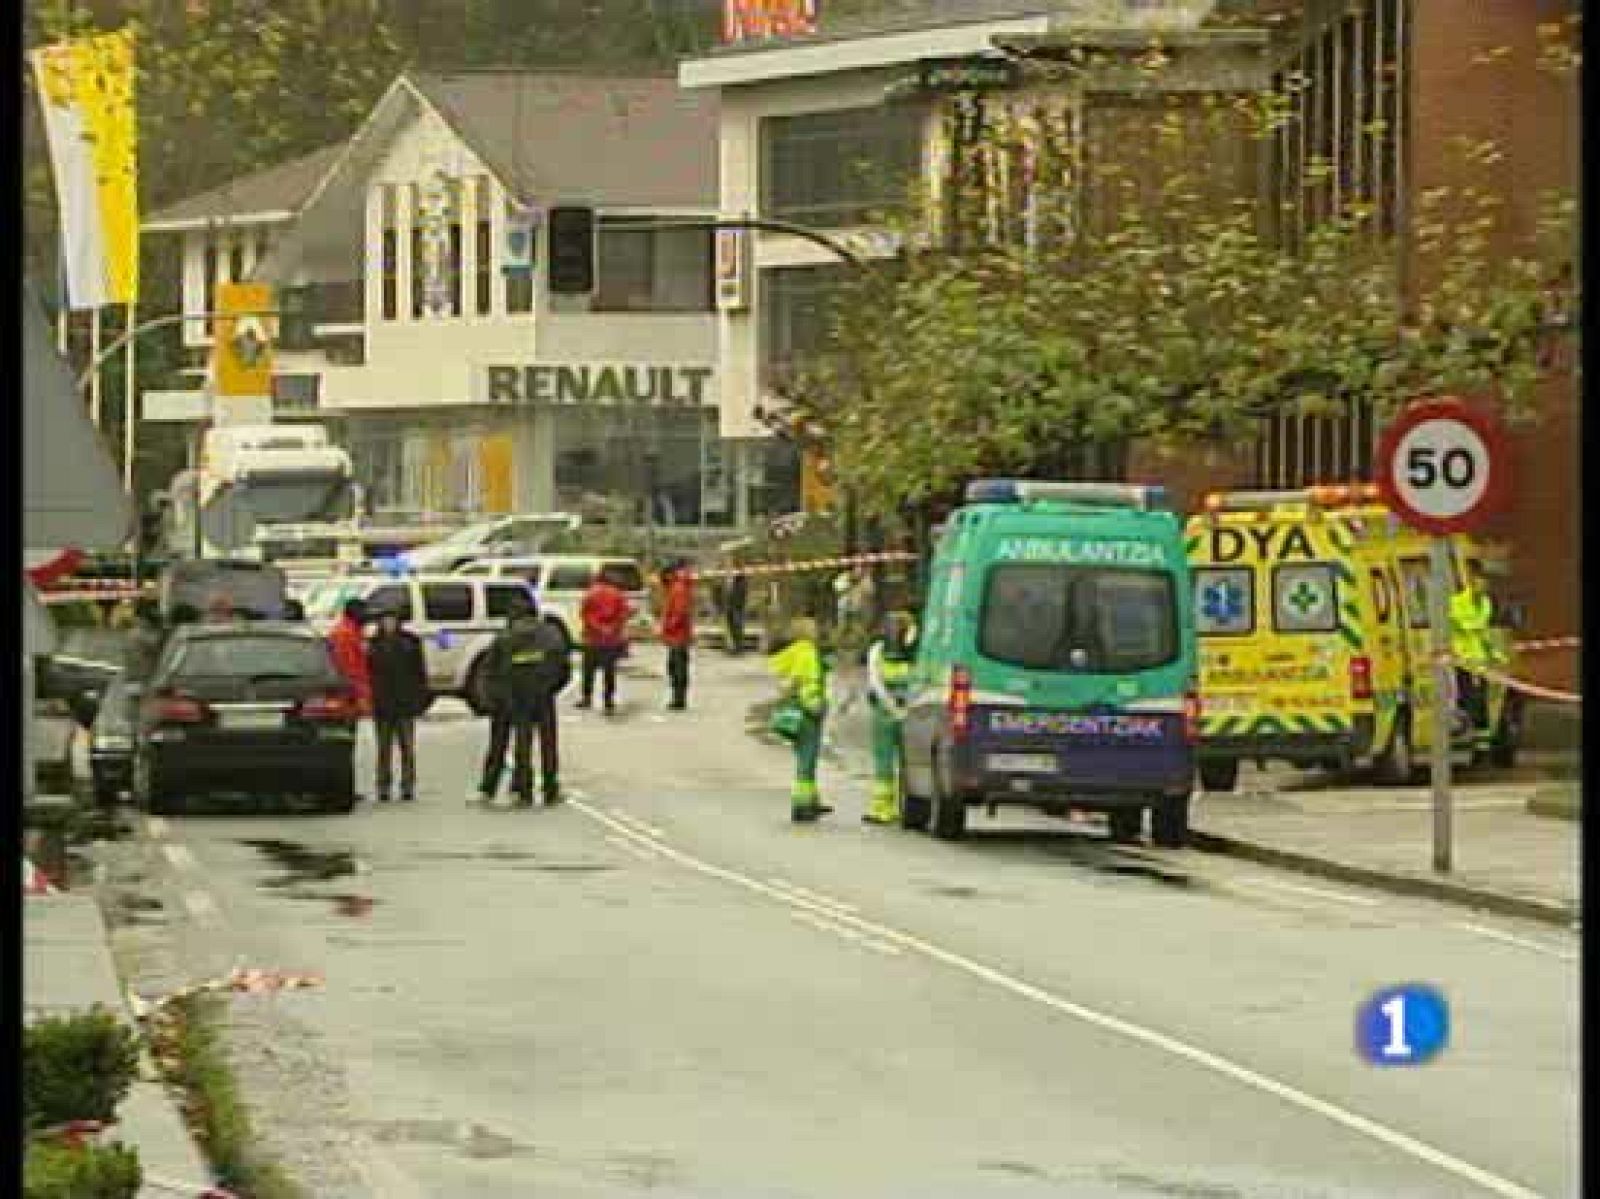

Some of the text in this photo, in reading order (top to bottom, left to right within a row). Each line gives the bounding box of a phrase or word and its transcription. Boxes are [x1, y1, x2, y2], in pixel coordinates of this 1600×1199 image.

[488, 365, 713, 403] RENAULT
[1407, 447, 1475, 489] 50
[1211, 525, 1316, 563] DYA
